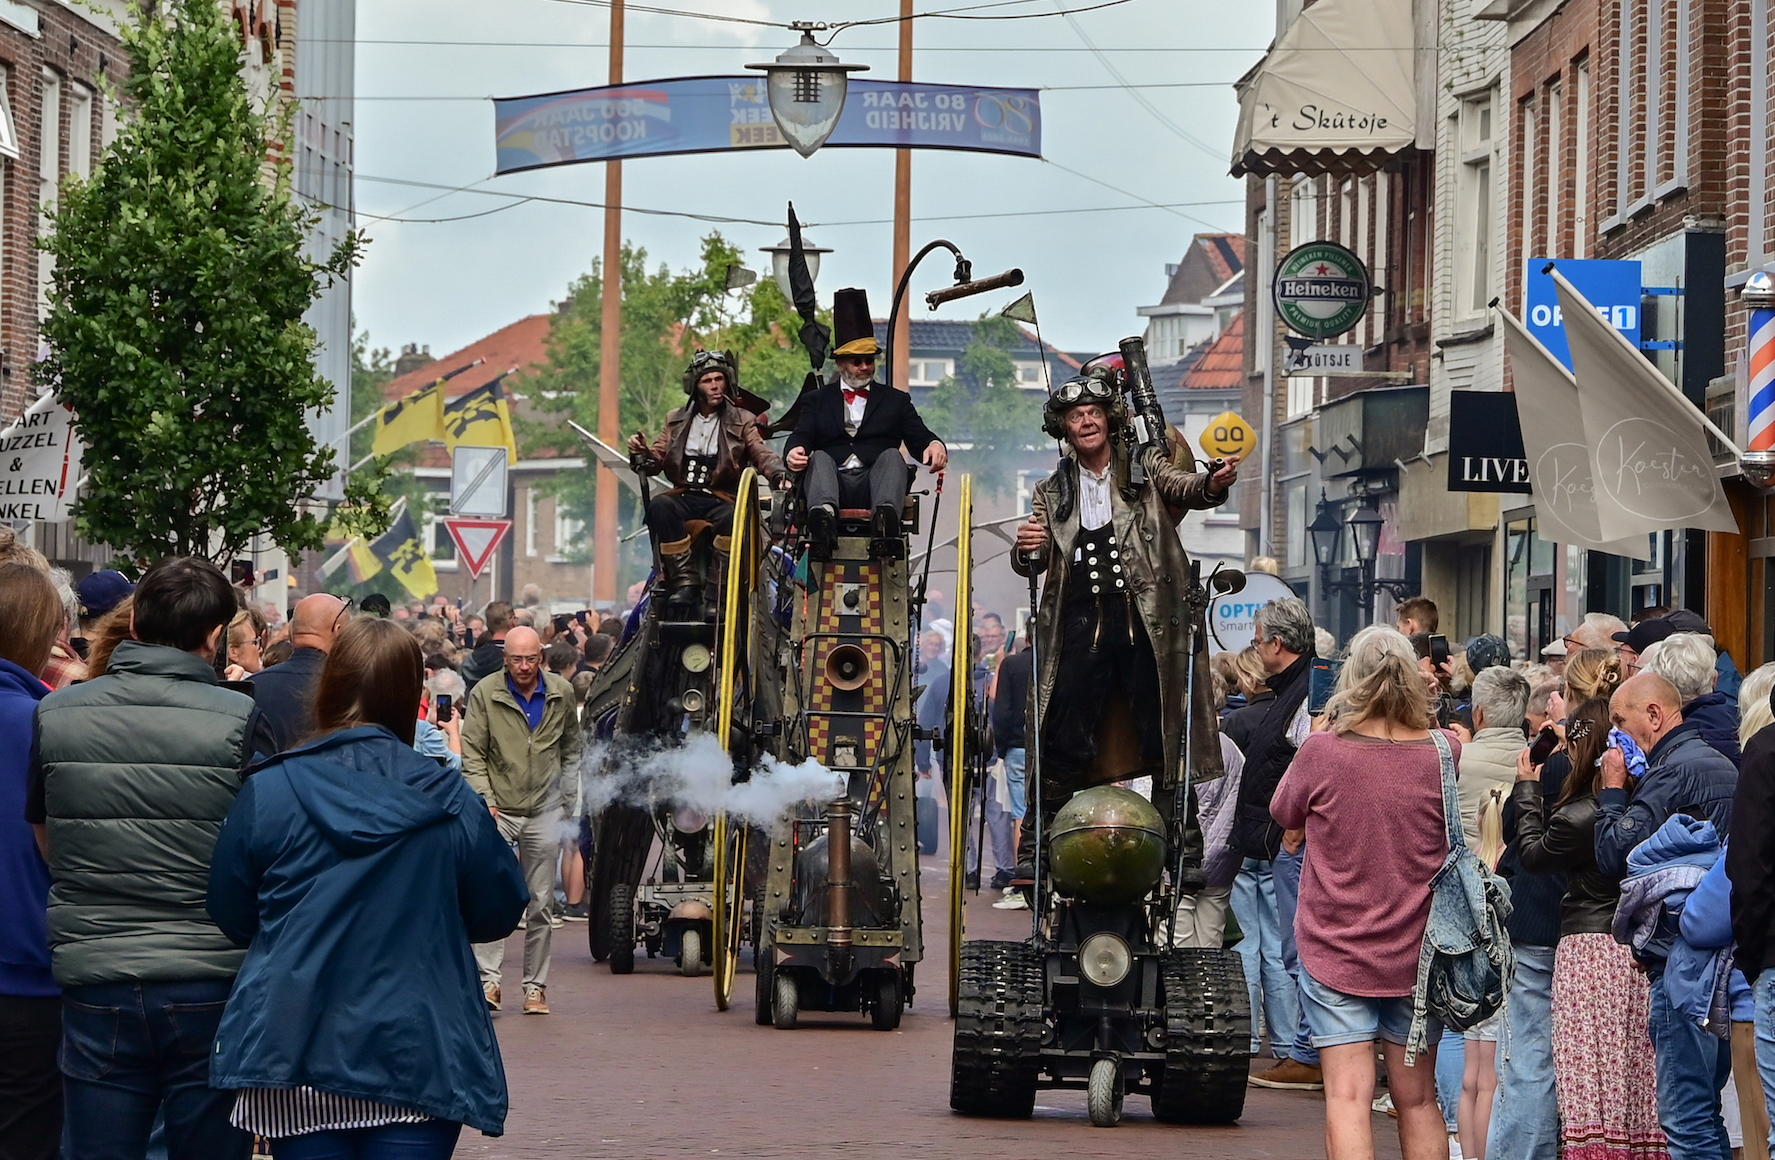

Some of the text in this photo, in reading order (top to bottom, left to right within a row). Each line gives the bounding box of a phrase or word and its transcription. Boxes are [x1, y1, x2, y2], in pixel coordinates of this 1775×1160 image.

[1292, 104, 1388, 135] Skûtsje
[1284, 281, 1359, 297] Heineken
[9, 457, 23, 472] &
[1616, 435, 1706, 495] Koester
[1552, 458, 1597, 513] Koes
[1219, 603, 1264, 618] OPT
